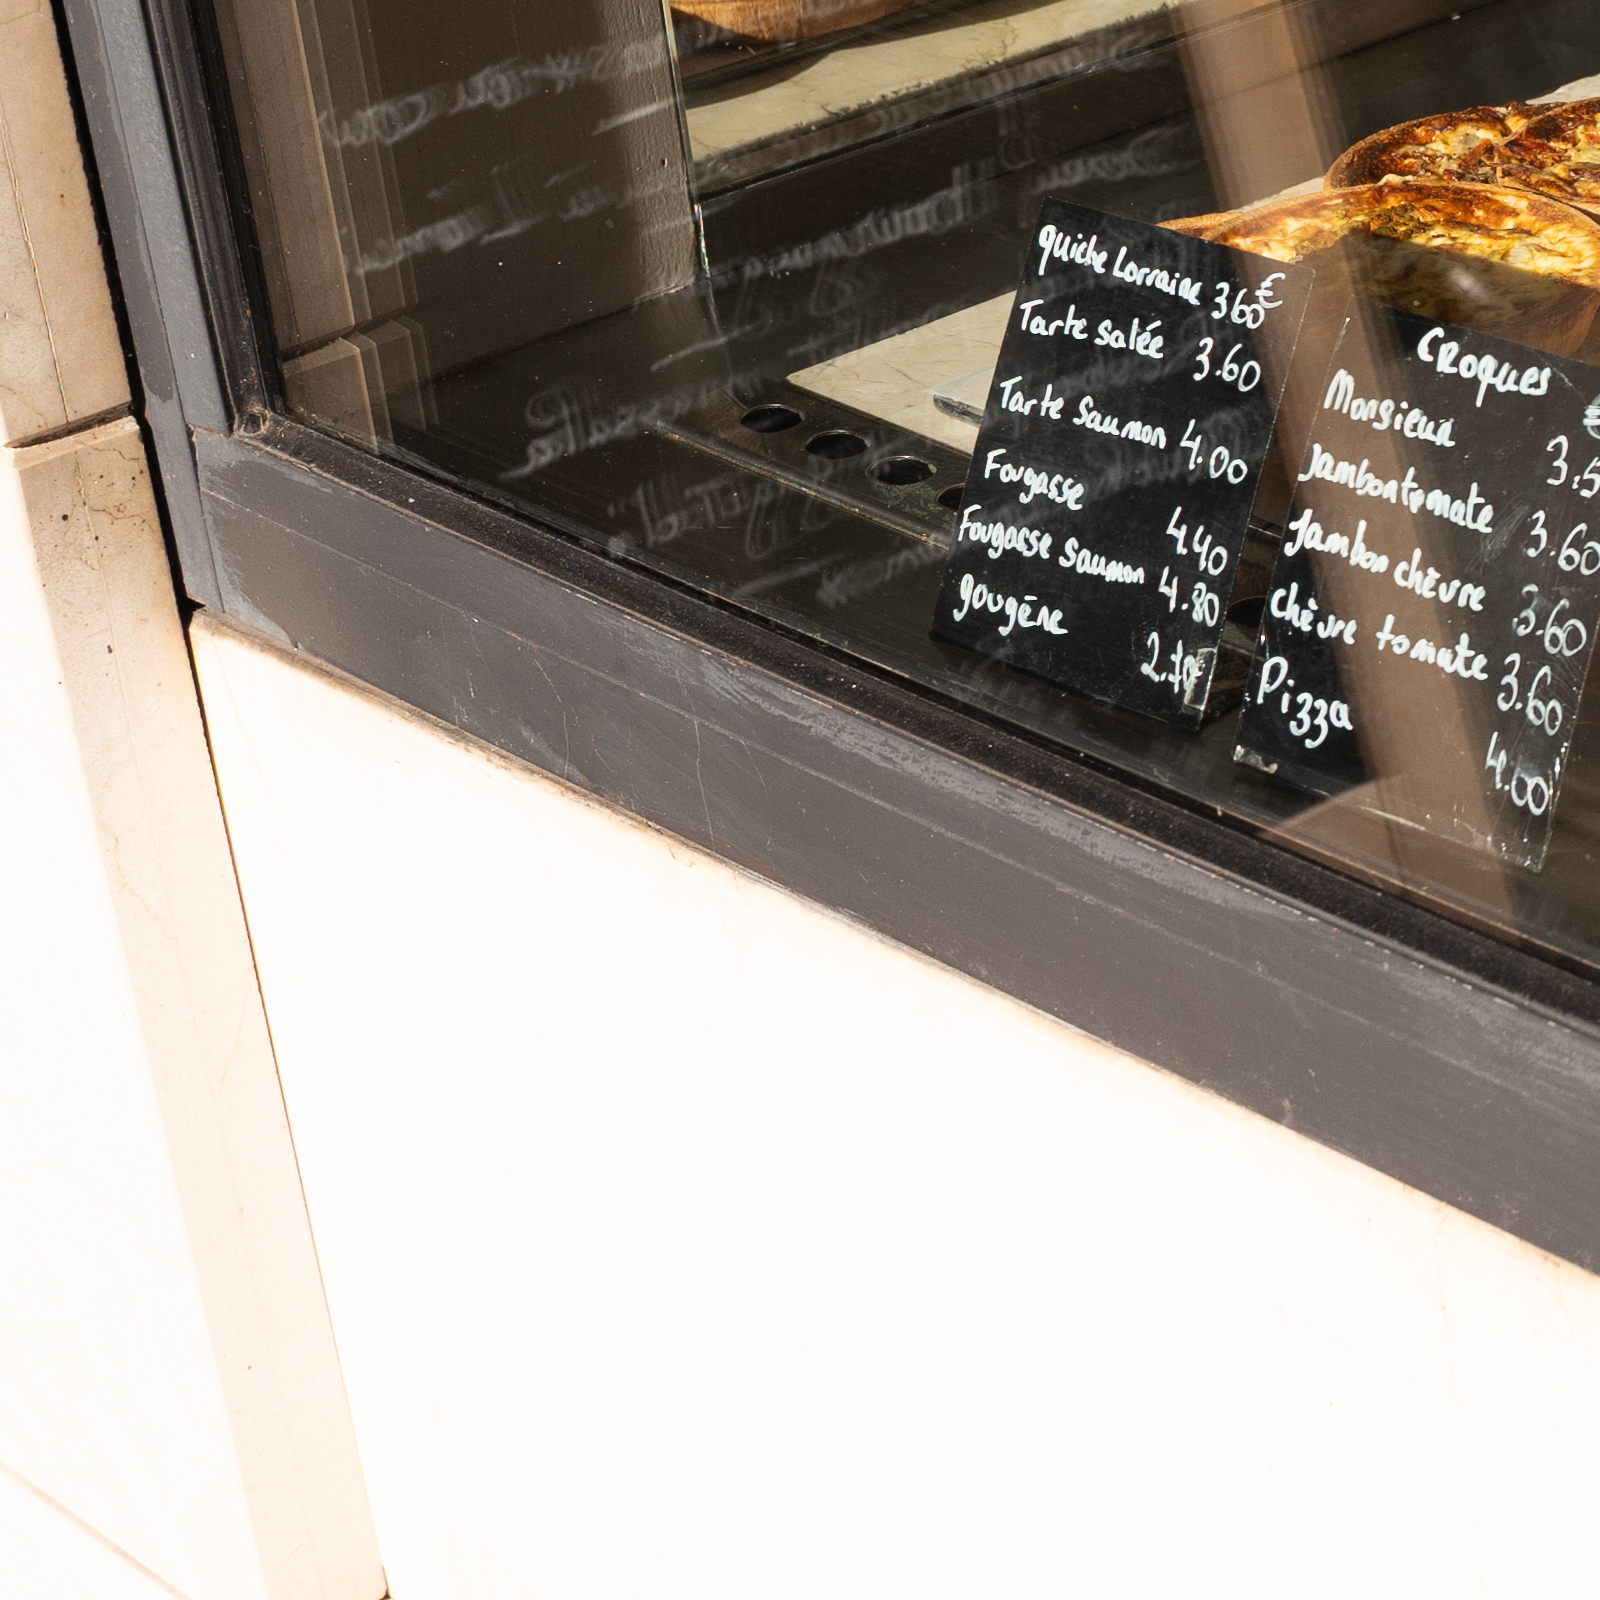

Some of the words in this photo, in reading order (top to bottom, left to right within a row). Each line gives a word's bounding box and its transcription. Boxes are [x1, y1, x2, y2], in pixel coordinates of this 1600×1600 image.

[1112, 245, 1202, 305] Lorraine
[1020, 299, 1088, 340] Tarte
[1193, 336, 1261, 392] 3.60
[1000, 376, 1064, 420] Tarte
[1180, 418, 1248, 485] 4.00
[1323, 368, 1456, 447] Monsieur
[984, 448, 1085, 511] Fougasse
[958, 504, 1052, 559] Fougasse
[1158, 566, 1220, 628] 4.80
[1284, 508, 1390, 574] Jambon
[1257, 656, 1354, 749] Pizza
[1375, 614, 1489, 681] tomate
[1497, 652, 1563, 736] 3.60
